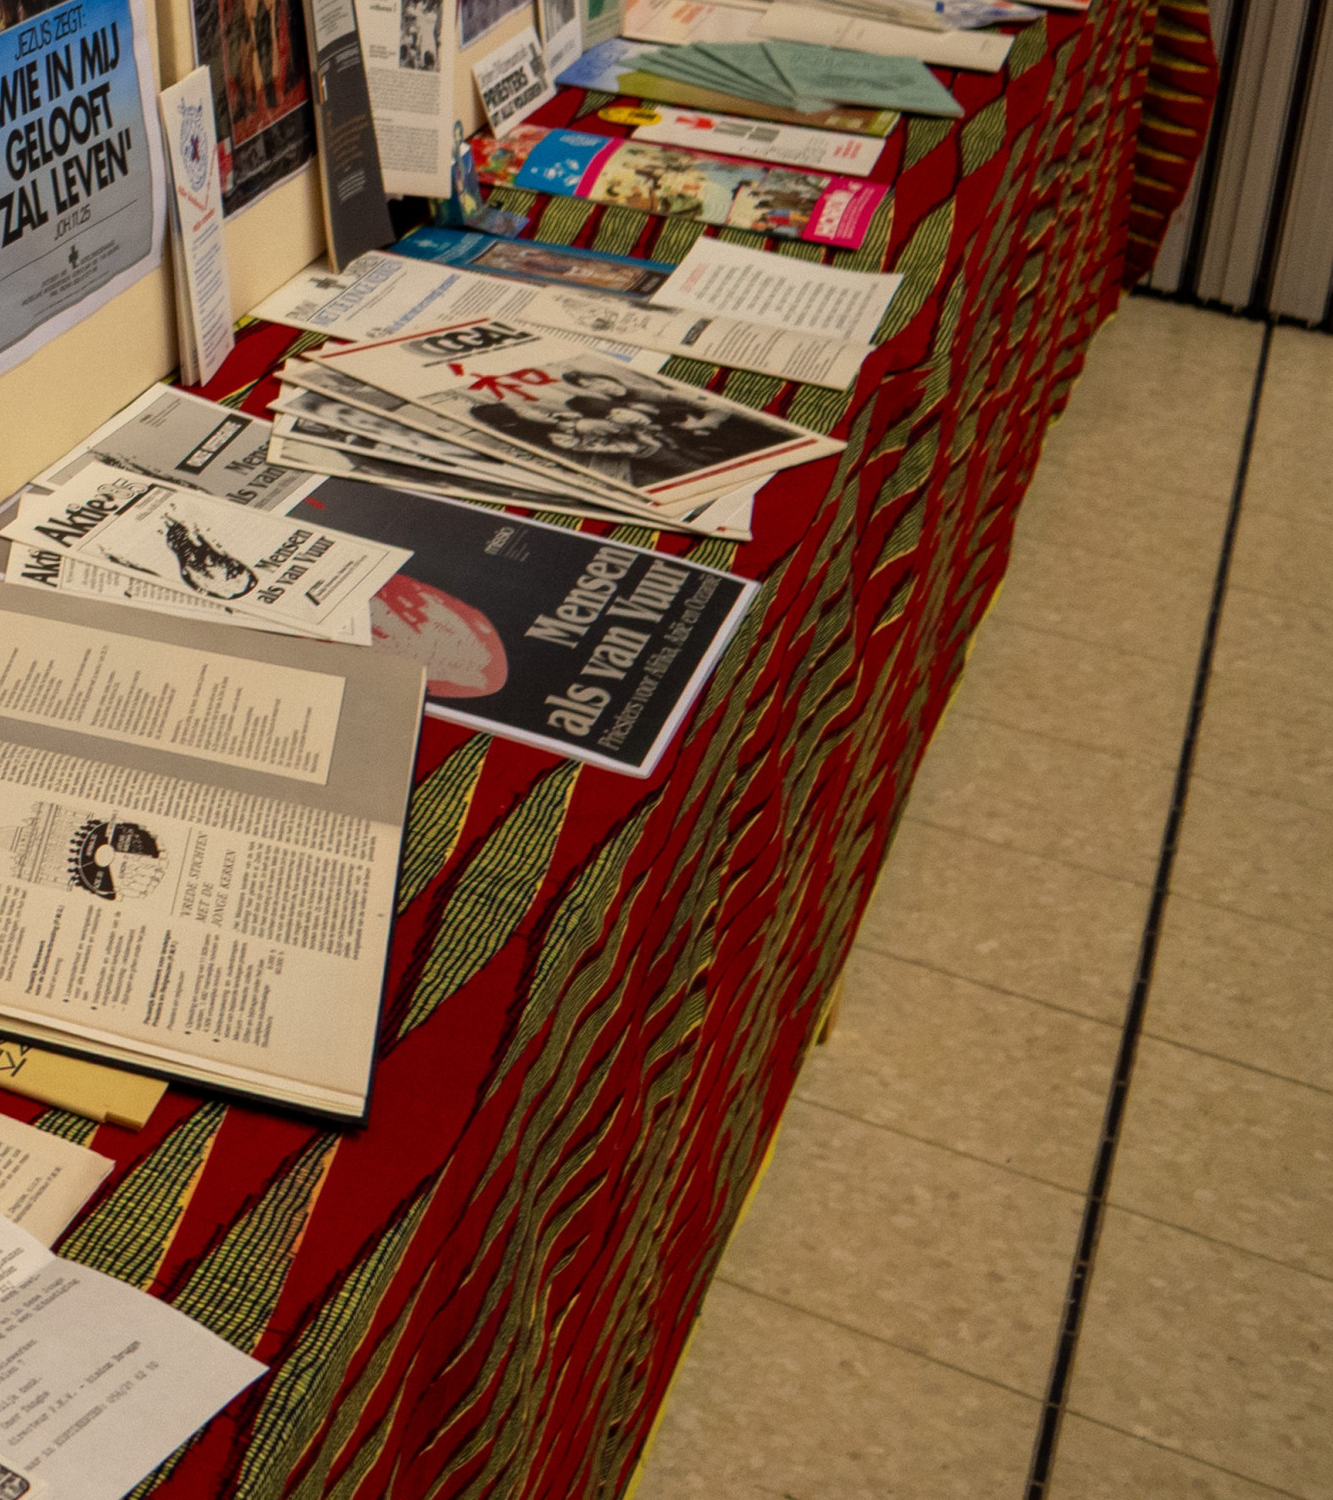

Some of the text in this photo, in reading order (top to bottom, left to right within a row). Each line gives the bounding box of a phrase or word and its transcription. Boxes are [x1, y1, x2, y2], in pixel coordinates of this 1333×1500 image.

[14, 5, 87, 61] JEZUS ZEGT:
[45, 43, 74, 103] IN
[81, 21, 120, 86] MIJ
[5, 81, 114, 181] GELOOFT
[254, 528, 314, 575] Mensen
[257, 534, 336, 605] als van Vuur
[524, 546, 639, 650] Mensen
[544, 558, 692, 738] als van Vuur
